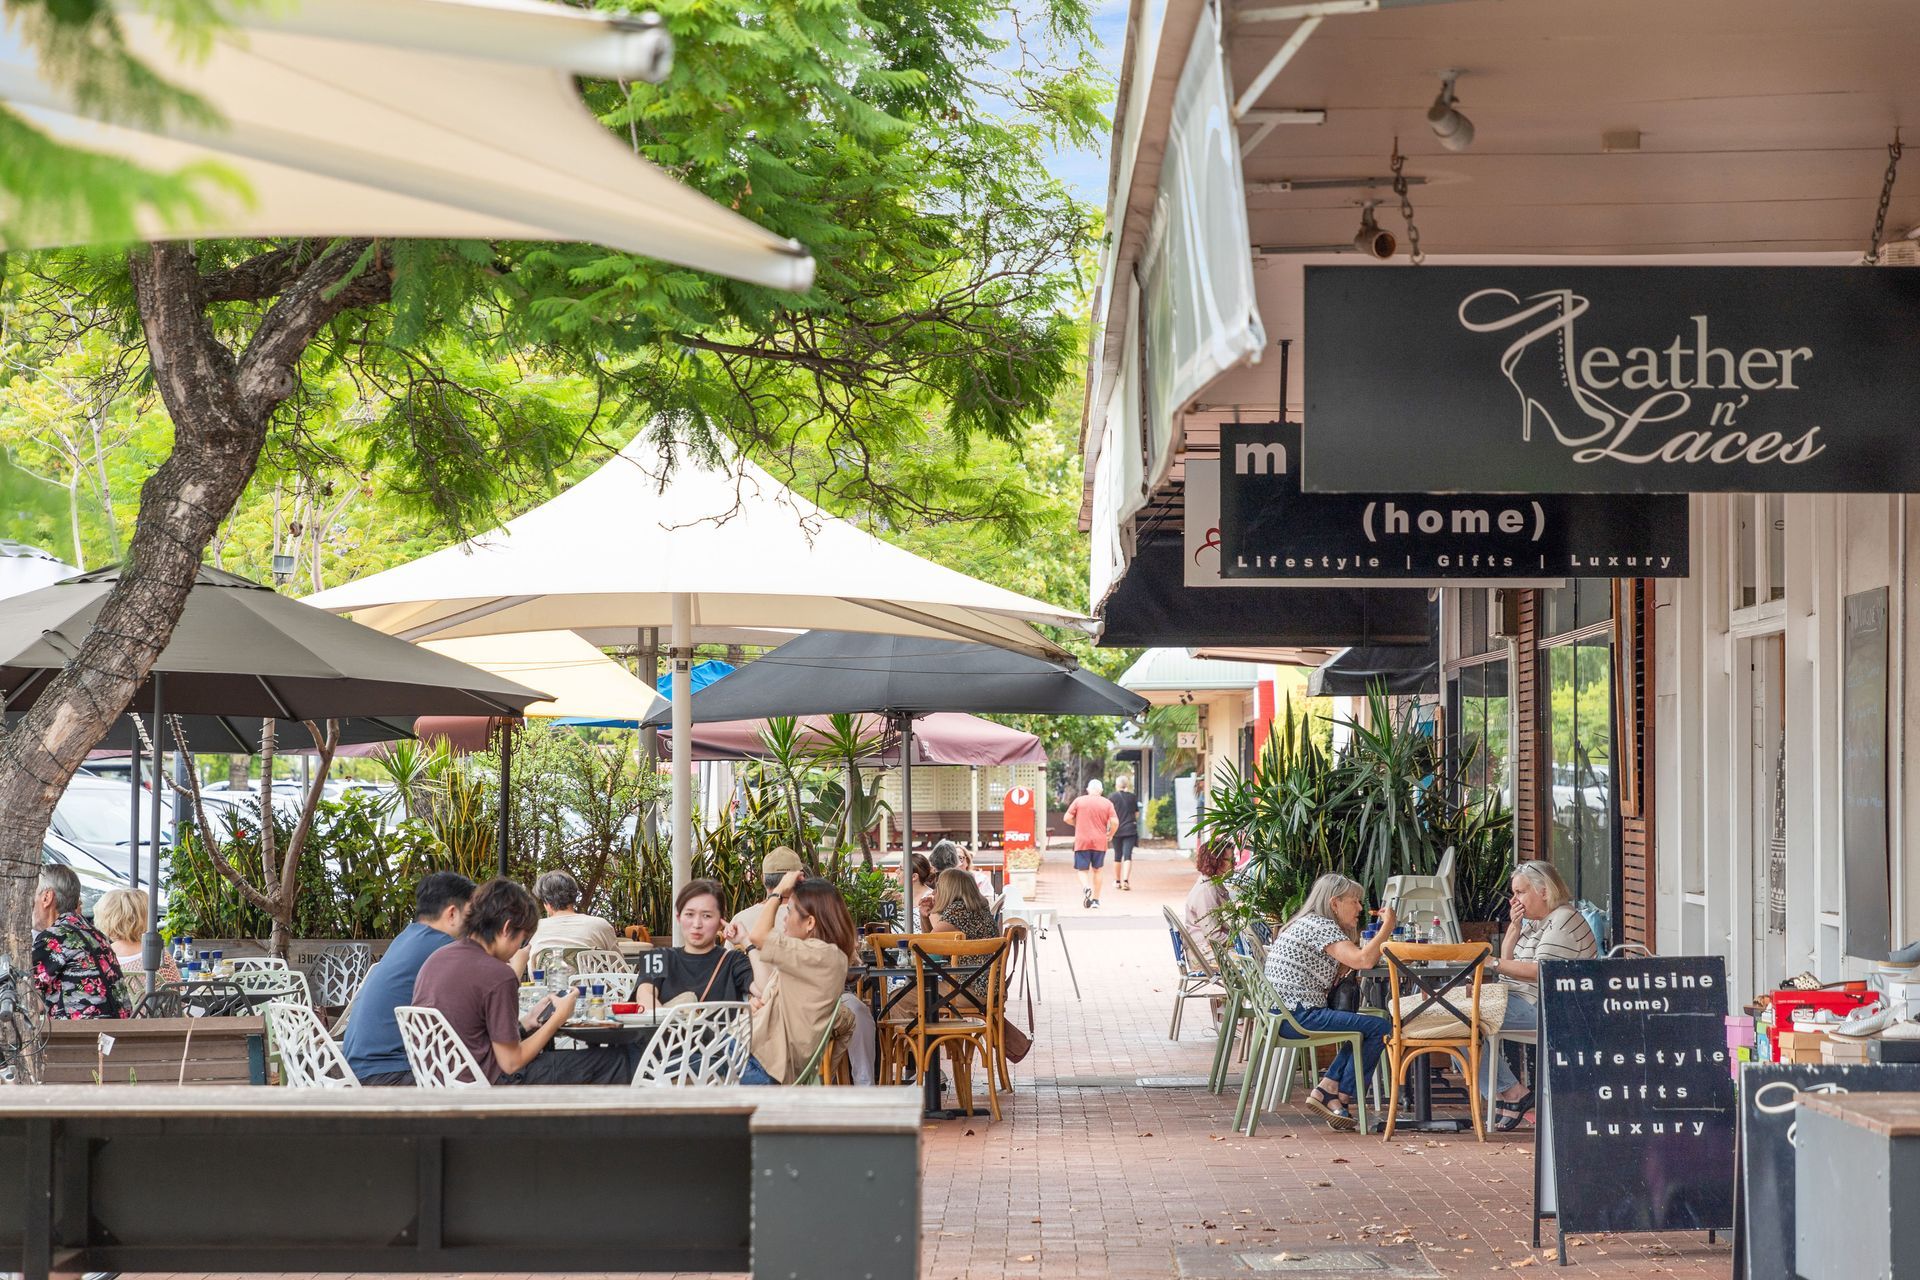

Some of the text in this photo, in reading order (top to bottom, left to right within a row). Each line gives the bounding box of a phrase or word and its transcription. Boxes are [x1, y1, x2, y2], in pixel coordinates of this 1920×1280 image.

[1572, 391, 1826, 463] Laces
[1363, 502, 1545, 542] (home)
[1237, 555, 1380, 571] Lifestyle
[1437, 554, 1513, 568] Gifts
[1571, 554, 1671, 569] Luxury
[1006, 833, 1030, 842] POST
[883, 903, 895, 918] 12
[643, 953, 664, 974] 15
[1556, 972, 1713, 992] ma cuisine
[1603, 997, 1669, 1014] (home)
[1556, 1049, 1724, 1067] Lifestyle
[1598, 1084, 1688, 1100] Gifts
[1585, 1120, 1704, 1137] Luxury
